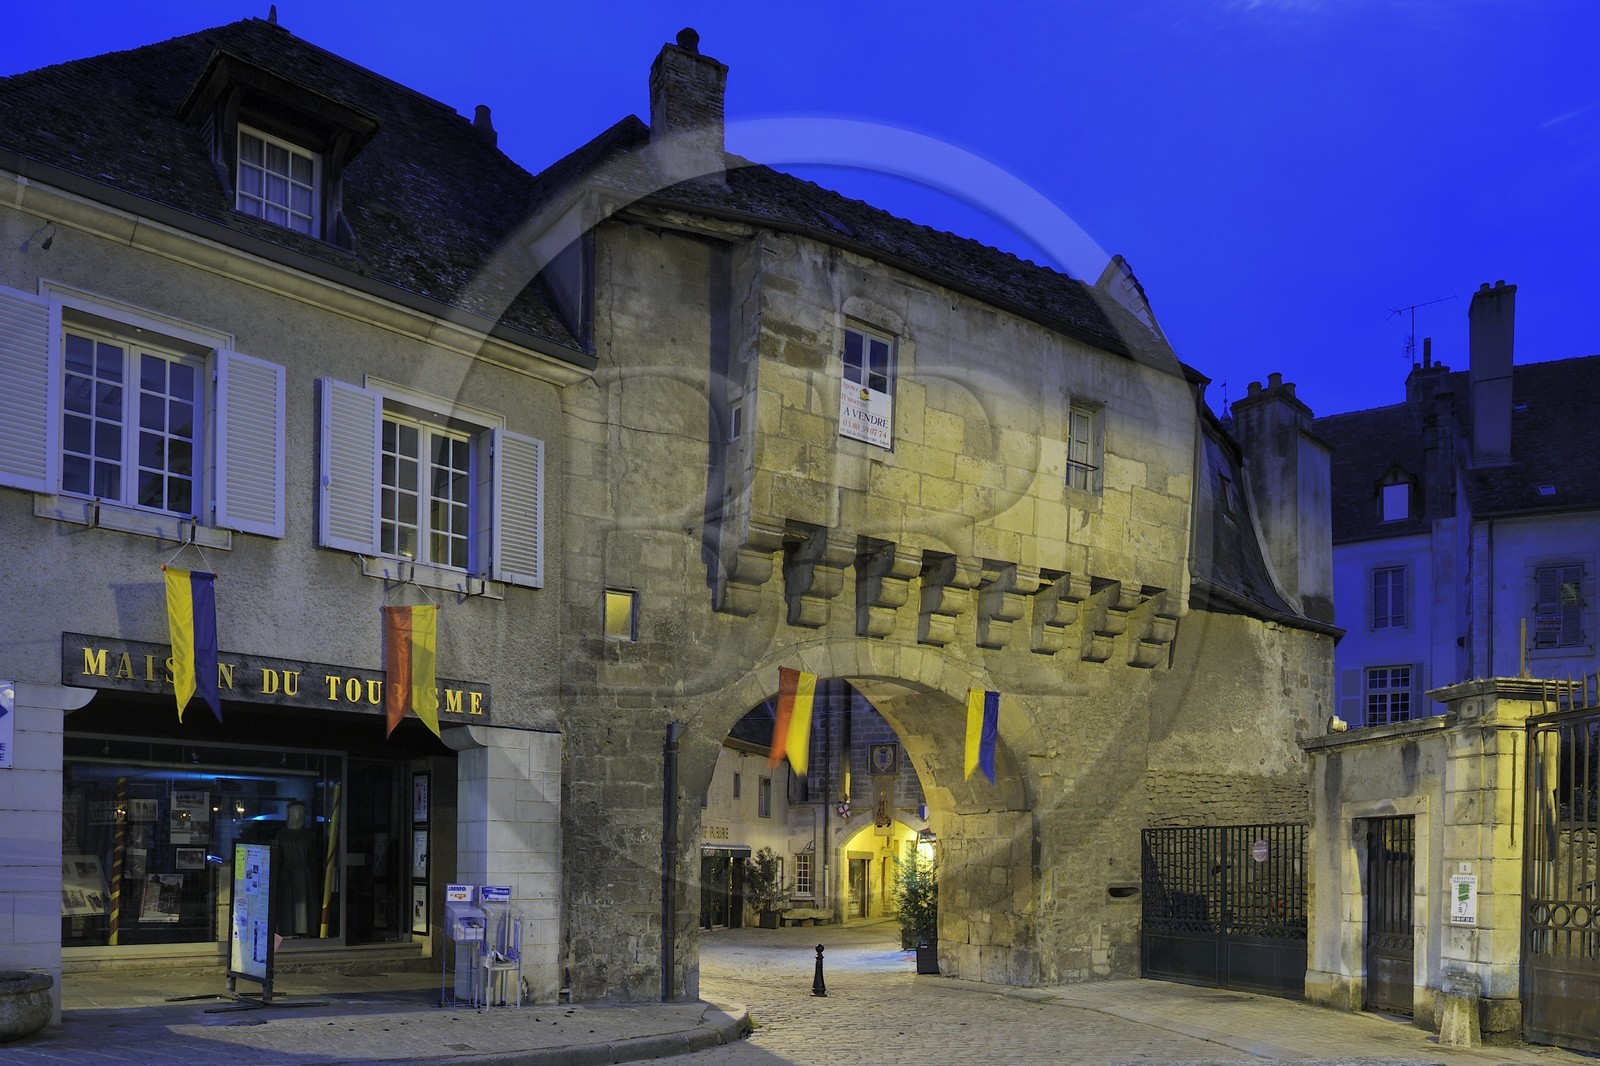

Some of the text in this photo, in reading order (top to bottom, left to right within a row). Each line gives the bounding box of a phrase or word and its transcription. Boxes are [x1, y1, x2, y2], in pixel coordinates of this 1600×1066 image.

[844, 406, 888, 428] A VENDRE
[852, 422, 860, 430] 80
[870, 428, 877, 436] 07
[879, 430, 887, 438] 74
[82, 647, 236, 690] MAISN
[261, 668, 299, 696] DU
